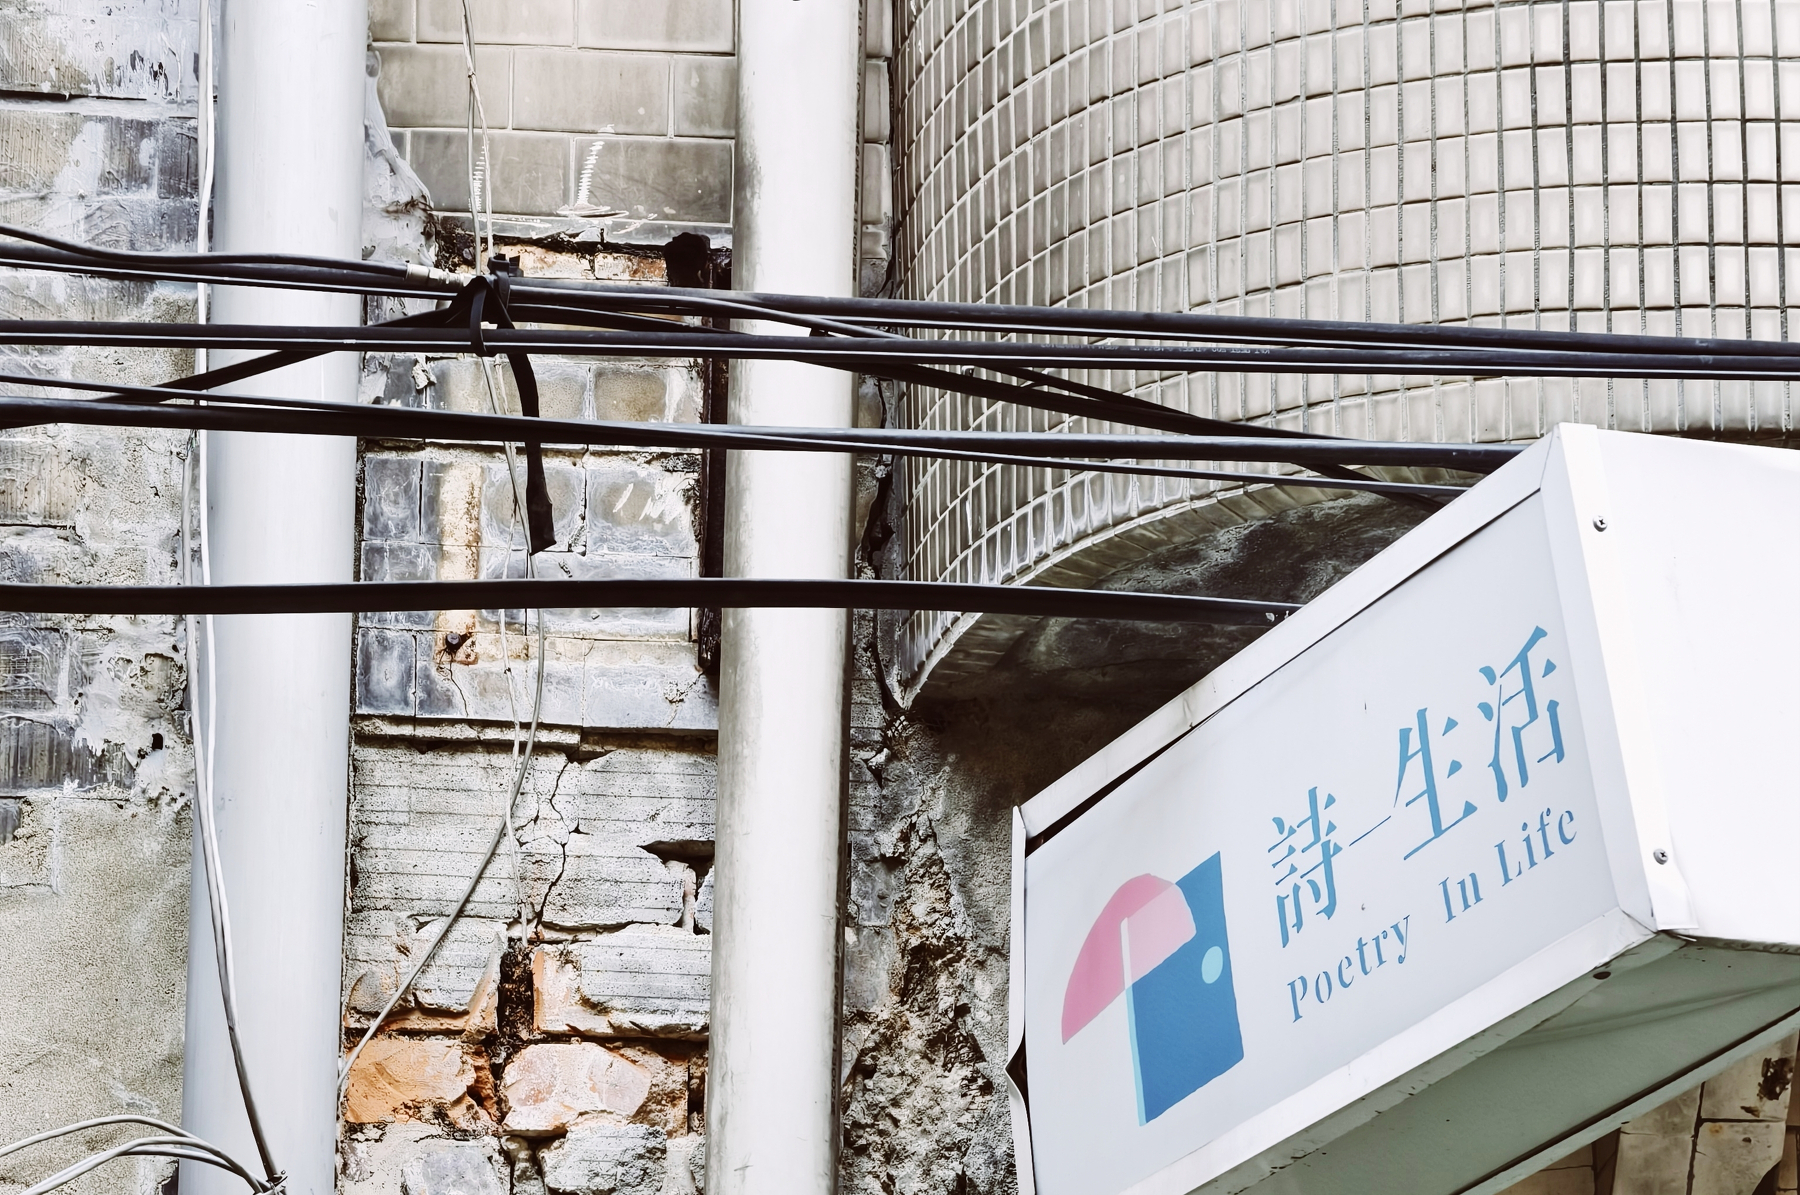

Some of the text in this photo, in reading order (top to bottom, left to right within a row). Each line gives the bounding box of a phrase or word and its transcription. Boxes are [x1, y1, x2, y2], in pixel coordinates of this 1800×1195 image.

[1267, 625, 1566, 949] 詩一生活
[1286, 806, 1578, 1024] Poetry In Life
